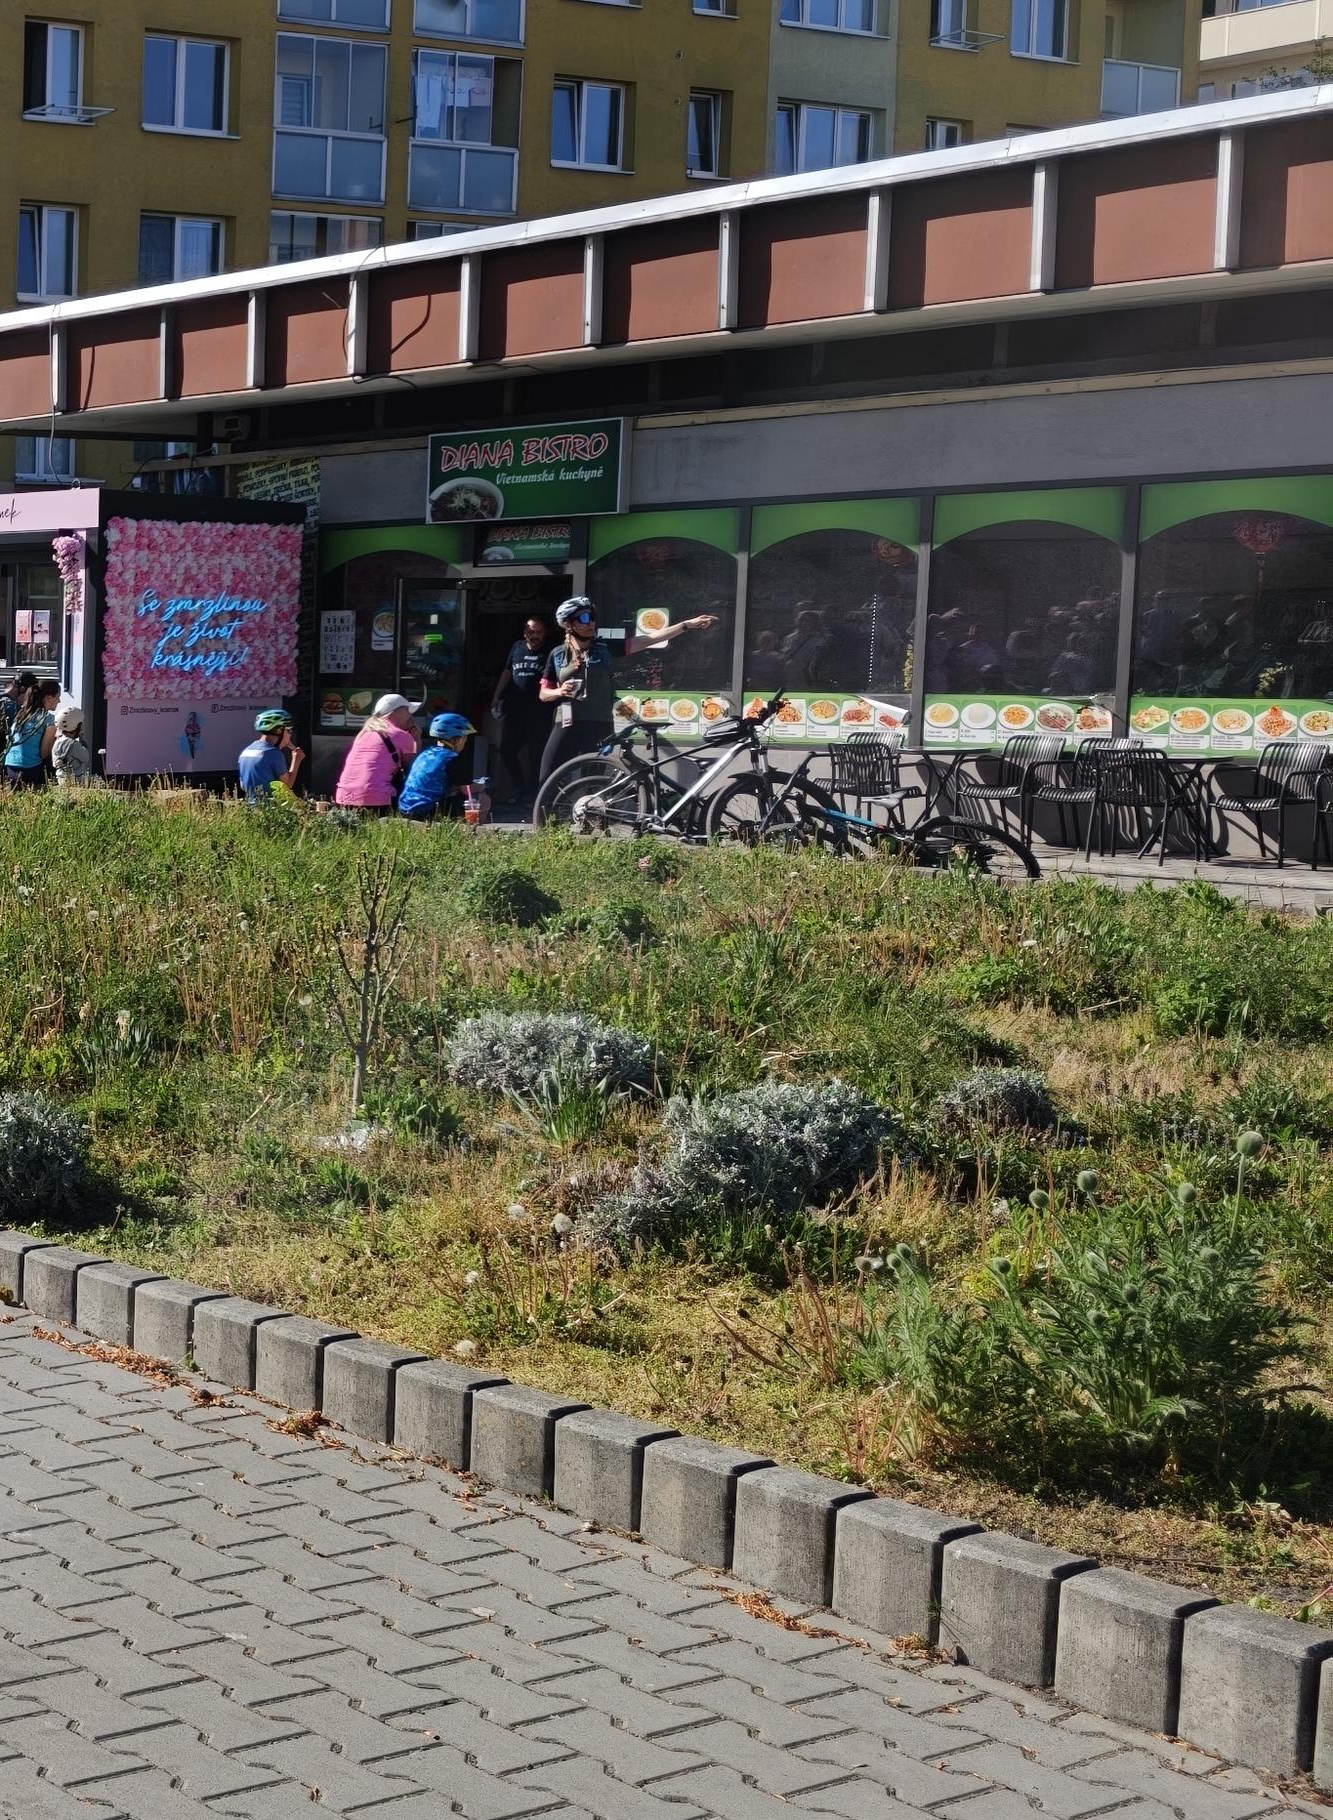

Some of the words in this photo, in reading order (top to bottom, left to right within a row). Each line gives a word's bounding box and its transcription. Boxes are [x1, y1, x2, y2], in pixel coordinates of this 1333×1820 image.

[441, 440, 514, 472] DIANA
[521, 433, 609, 465] BISTRO
[496, 470, 555, 485] Vietnamská
[559, 466, 604, 482] kuchyně
[138, 588, 162, 617] Se
[160, 590, 268, 622] zmrzlinou
[157, 622, 185, 648] je
[185, 617, 245, 648] život
